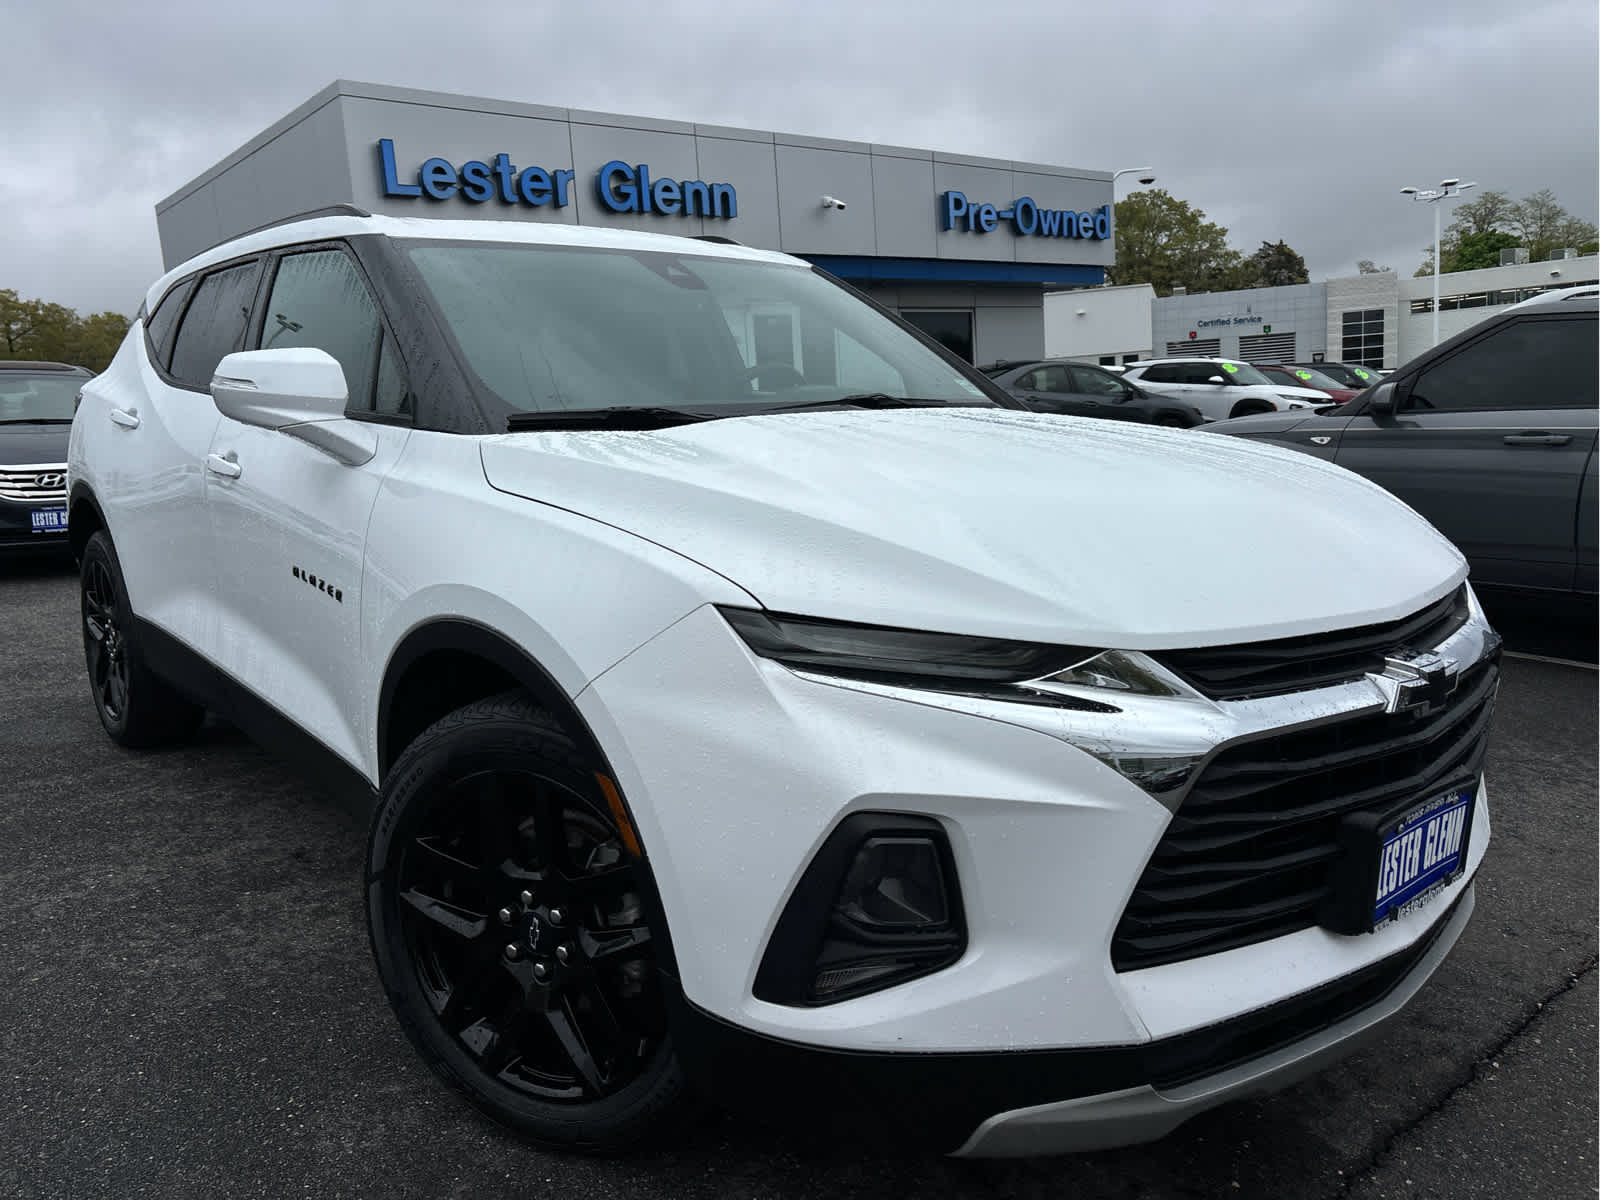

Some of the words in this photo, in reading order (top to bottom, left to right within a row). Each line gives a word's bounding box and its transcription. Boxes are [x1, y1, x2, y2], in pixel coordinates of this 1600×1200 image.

[378, 138, 574, 208] Lester
[598, 160, 738, 219] Glenn
[943, 190, 1111, 240] Pre-Owned
[1197, 318, 1231, 328] Certified
[1233, 316, 1262, 325] Service
[32, 511, 59, 526] LESTER
[292, 565, 343, 604] BLAZER
[1376, 826, 1423, 900] LESTER
[1423, 805, 1467, 870] GLENN
